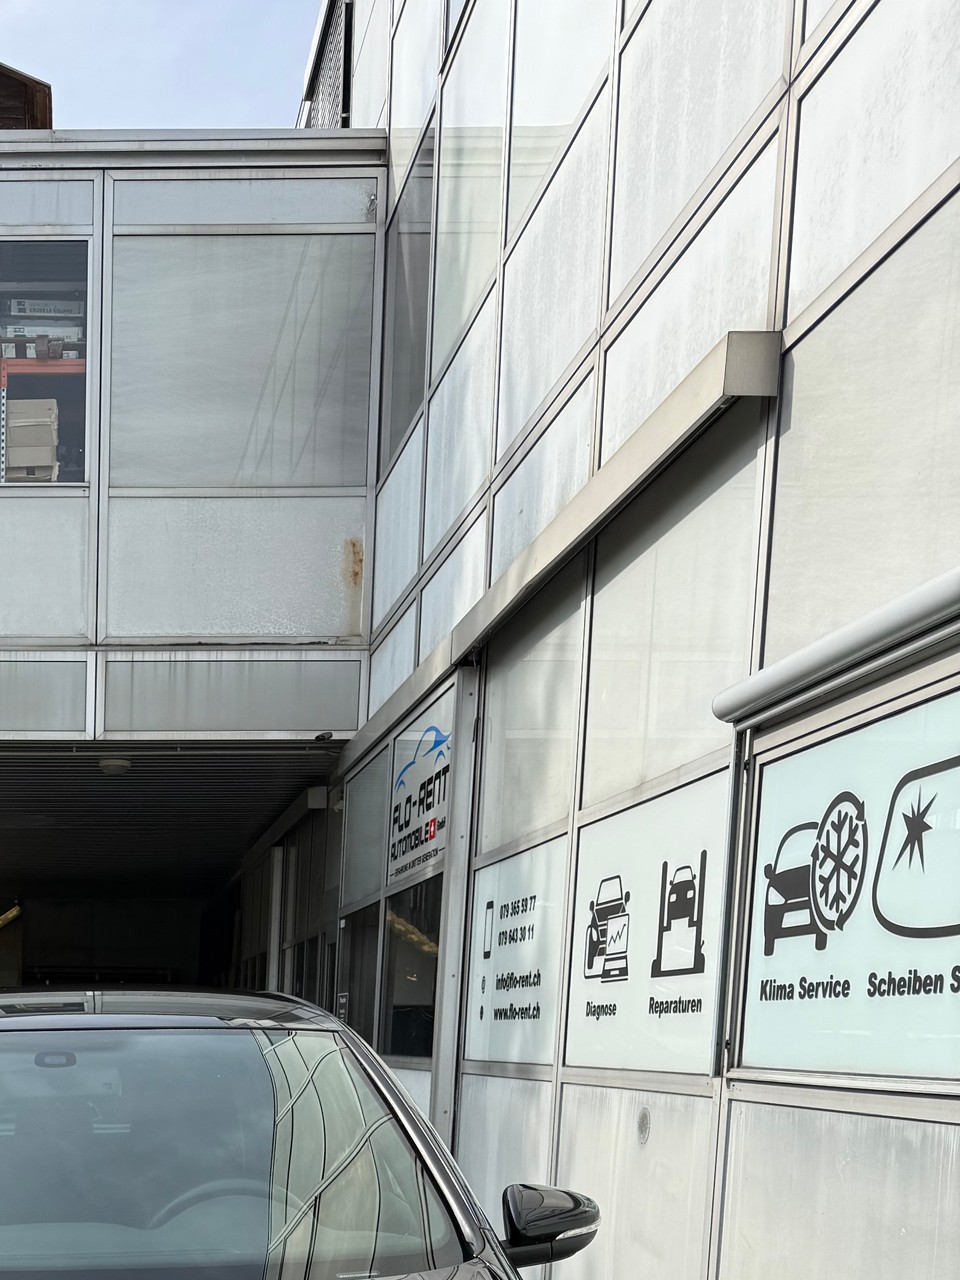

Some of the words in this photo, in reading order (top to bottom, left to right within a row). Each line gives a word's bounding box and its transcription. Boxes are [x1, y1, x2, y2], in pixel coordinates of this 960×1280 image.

[392, 764, 450, 838] FLO-RENT
[390, 821, 430, 863] AUTOMOBILE
[500, 902, 509, 920] 079
[510, 899, 520, 917] 365
[521, 897, 528, 914] 59
[529, 895, 537, 911] 77
[498, 930, 508, 947] 079
[508, 927, 519, 945] 643
[519, 925, 527, 942] 30
[527, 923, 535, 940] 11
[495, 968, 541, 992] info@flo-rent.ch
[759, 978, 795, 1001] Klima
[798, 974, 851, 1000] Service
[866, 968, 945, 998] Scheiben
[493, 1001, 541, 1021] www.flo-rent.ch
[585, 1001, 617, 1021] Diagnose
[648, 995, 703, 1019] Reparaturen
